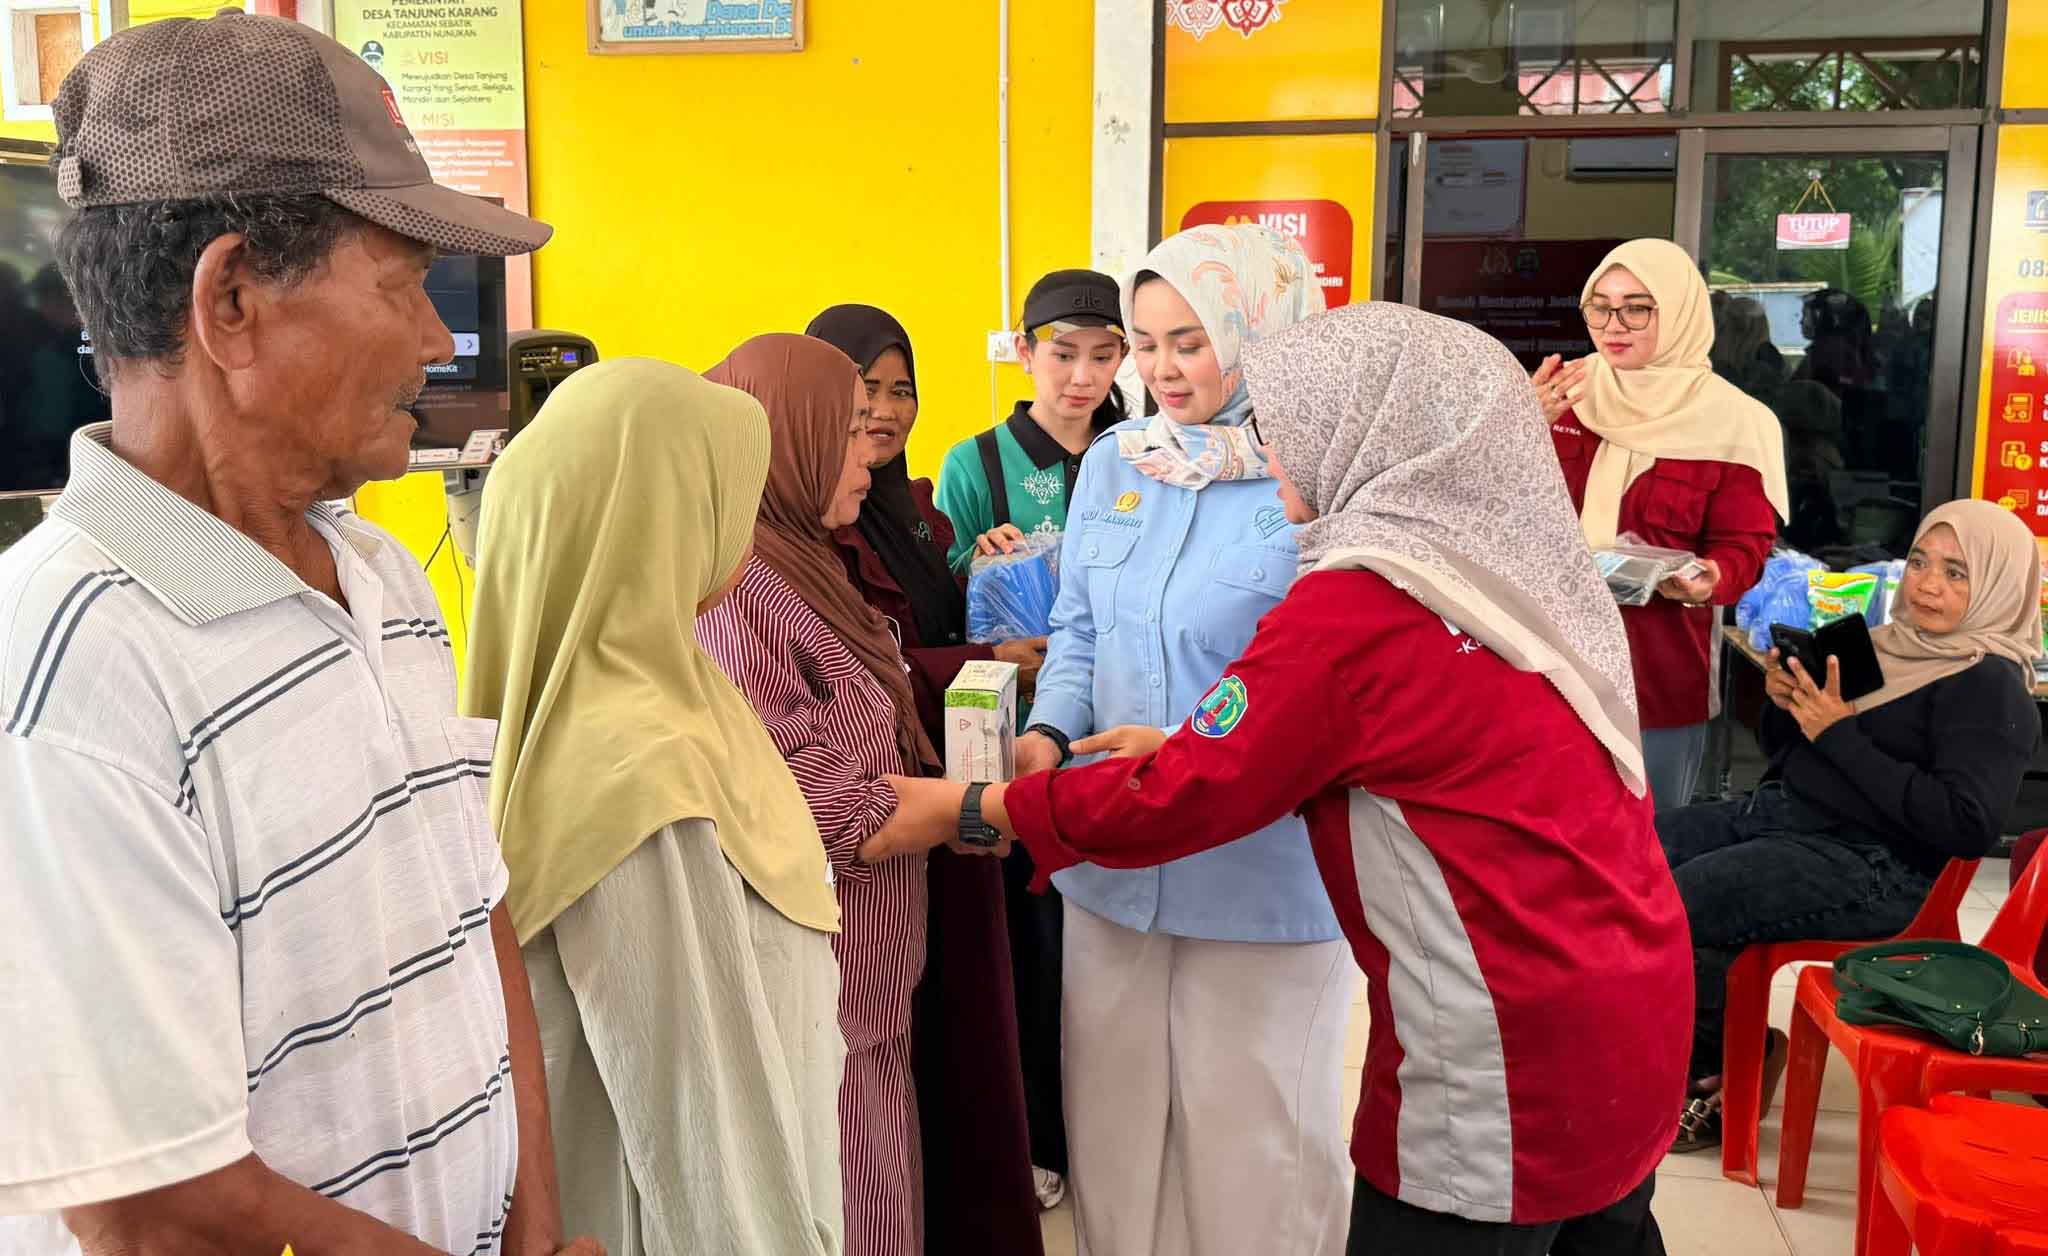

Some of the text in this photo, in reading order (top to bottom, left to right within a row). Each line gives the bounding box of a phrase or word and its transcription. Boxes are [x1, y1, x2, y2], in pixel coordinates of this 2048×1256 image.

[362, 7, 498, 19] DESA TANJUNG KARANG
[706, 1, 758, 20] Dana
[386, 19, 472, 29] KECAMATAN SEBATIK
[383, 29, 477, 39] KABUPATEN NUNUKAN
[622, 24, 665, 38] untuk
[418, 51, 448, 65] VISI
[401, 71, 508, 82] Mewujudkan Desa Tanjung
[402, 84, 431, 95] Karang
[432, 84, 453, 94] Yang
[452, 95, 493, 105] Sejahtera
[422, 112, 455, 127] MISI
[1257, 213, 1307, 238] VISI
[1788, 216, 1841, 233] TUTUP
[2017, 257, 2048, 279] 08
[422, 364, 458, 374] HomeKit
